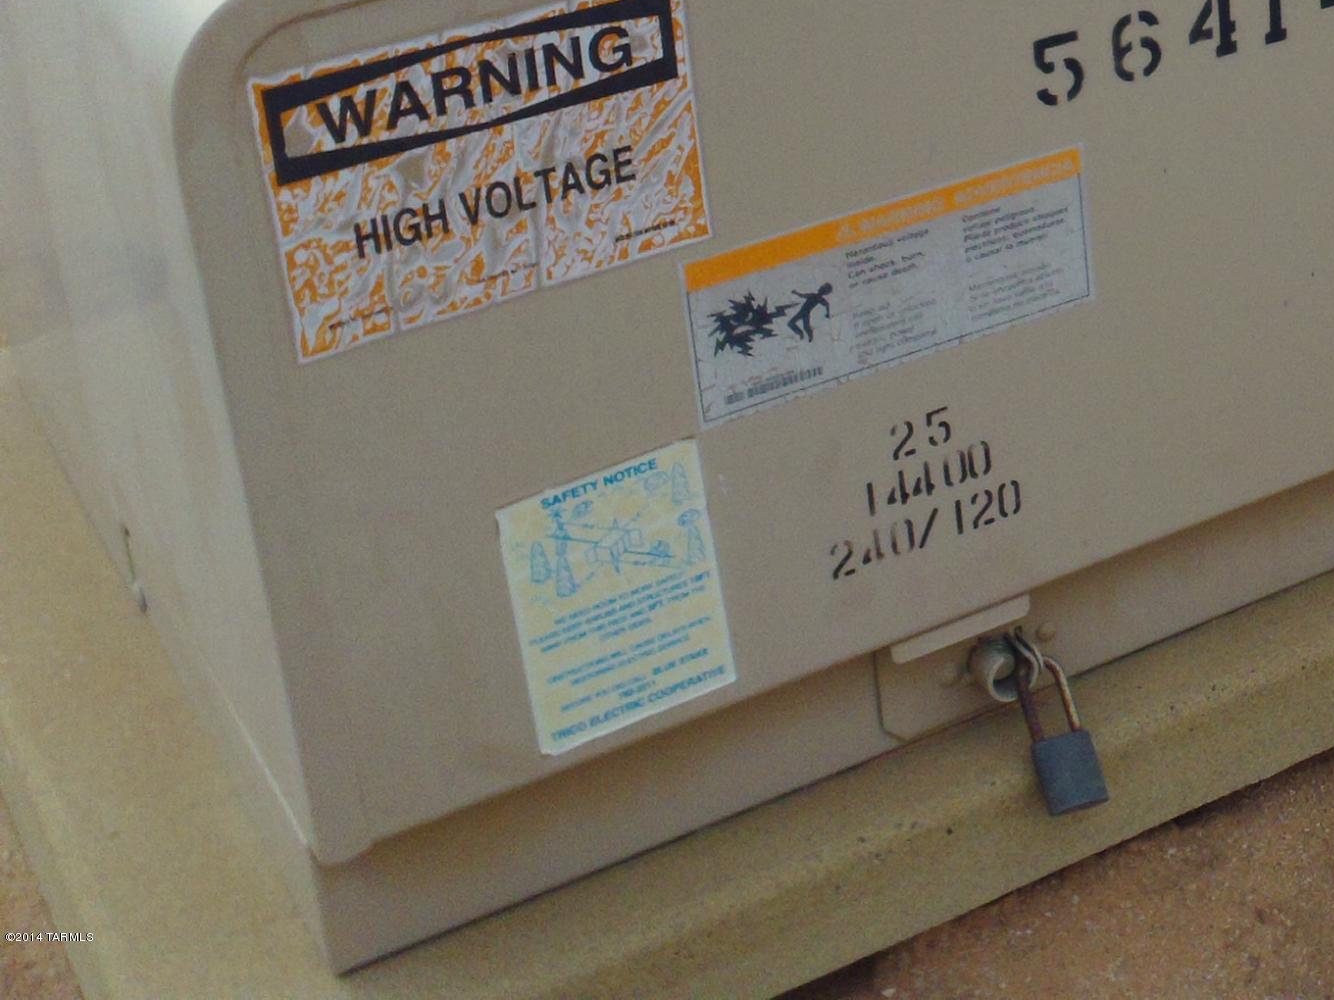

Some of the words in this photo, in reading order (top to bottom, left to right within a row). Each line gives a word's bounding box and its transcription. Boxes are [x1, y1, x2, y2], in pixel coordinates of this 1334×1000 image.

[316, 26, 634, 144] WARNING
[353, 204, 450, 259] HIGH
[458, 145, 637, 223] VOLTAGE
[890, 405, 951, 461] 25
[540, 478, 599, 510] SAFETY
[602, 457, 659, 486] NOTICE
[866, 439, 992, 516] 14400
[647, 664, 726, 702] COOPERATIVE
